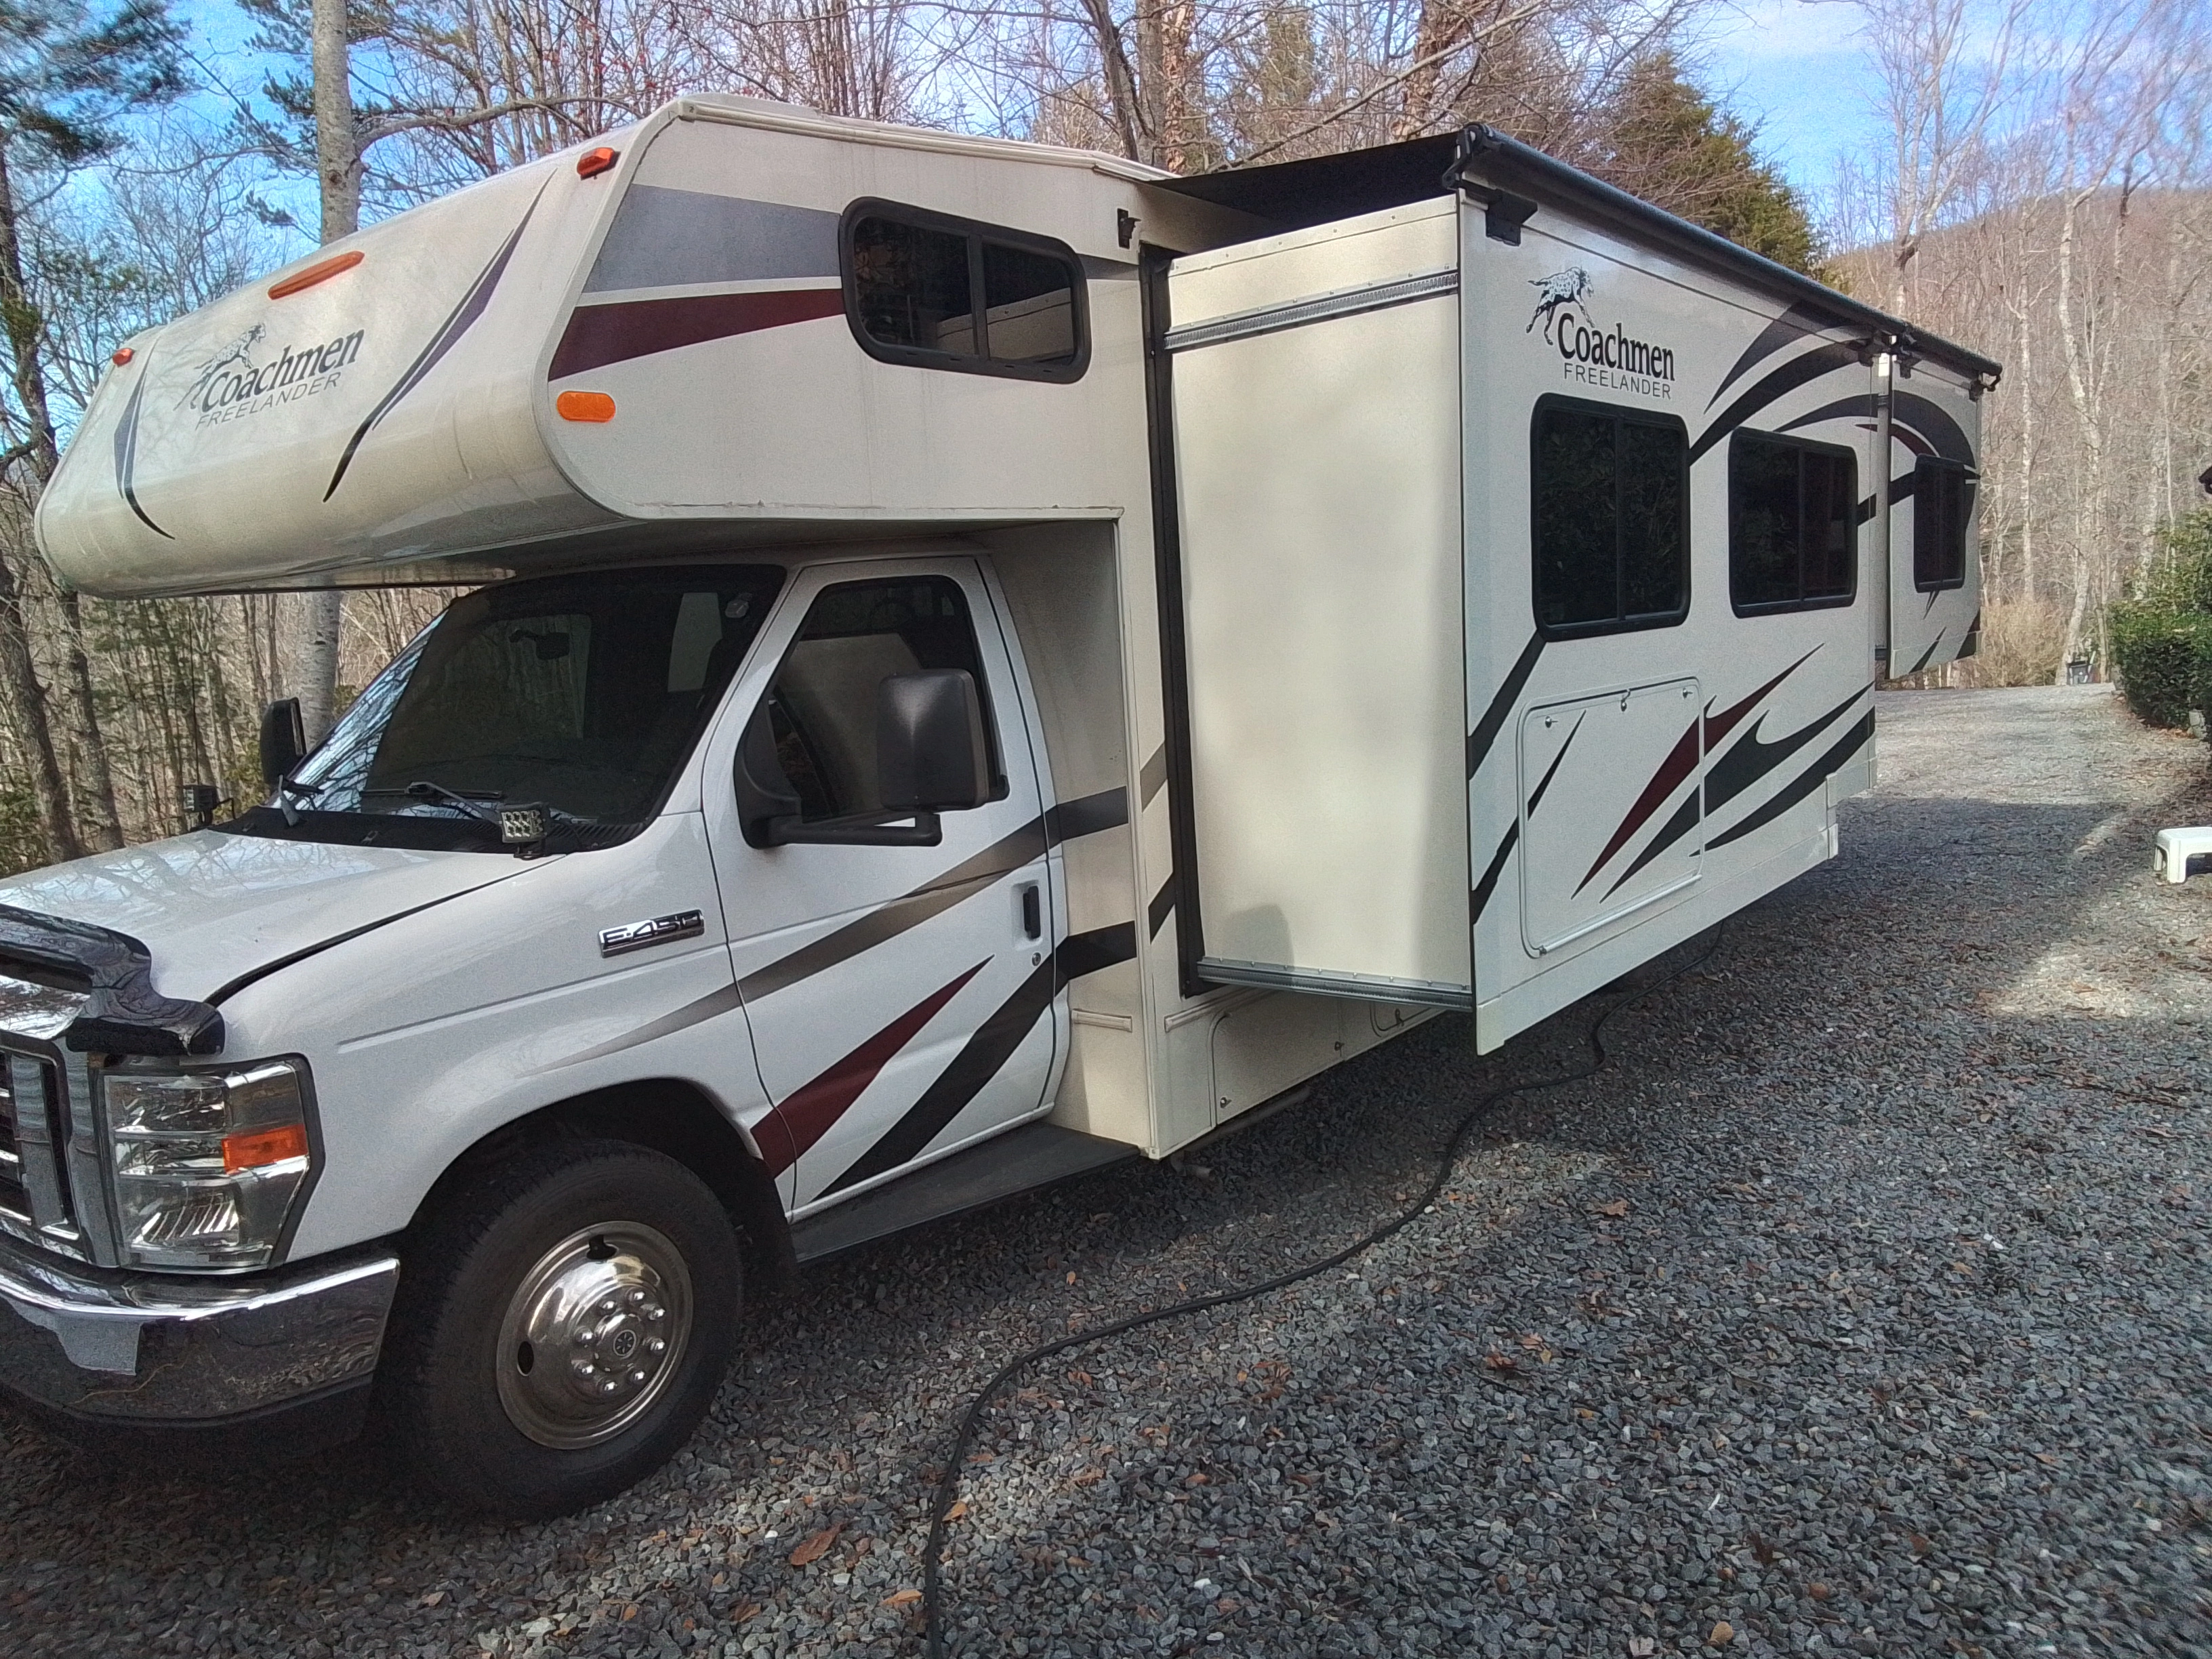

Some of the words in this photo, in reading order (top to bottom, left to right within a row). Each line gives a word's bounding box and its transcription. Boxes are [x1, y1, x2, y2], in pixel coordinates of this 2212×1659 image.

[203, 329, 365, 413] Coachmen
[1558, 312, 1675, 382] Coachmen
[194, 372, 341, 430] FREELANDER
[1564, 363, 1671, 400] FREELANDER
